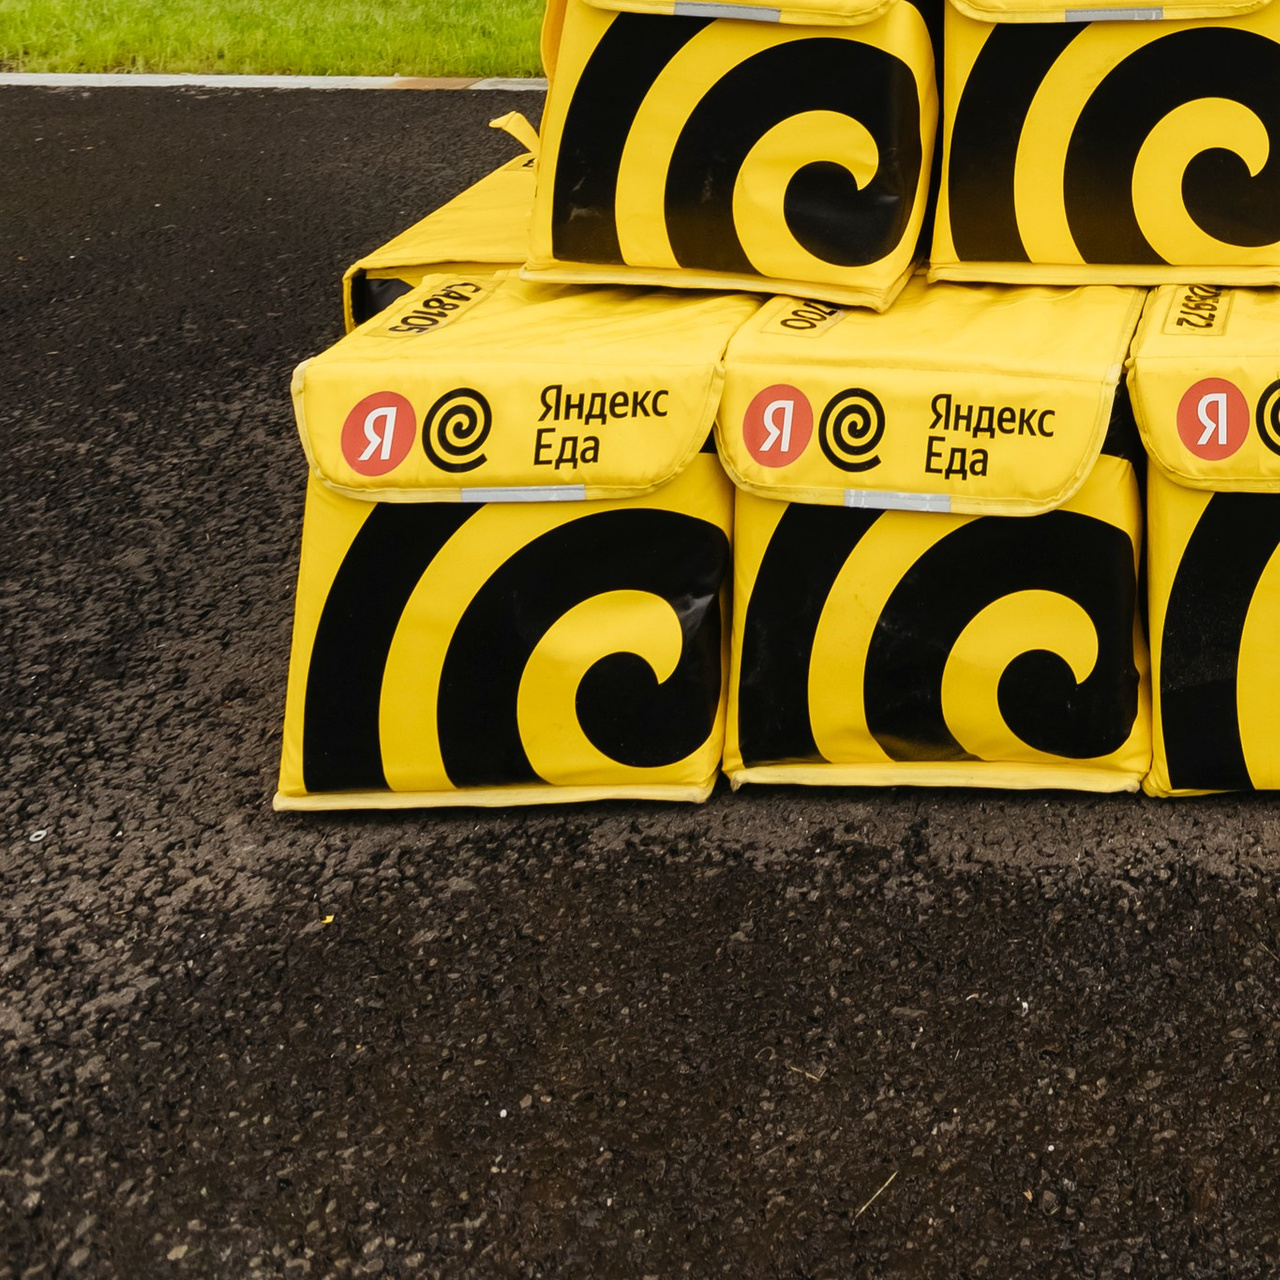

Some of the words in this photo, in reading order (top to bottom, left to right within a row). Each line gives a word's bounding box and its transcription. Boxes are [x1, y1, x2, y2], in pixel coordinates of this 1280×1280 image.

[387, 282, 482, 334] CA8105
[538, 384, 669, 426] Яндекс
[929, 393, 1056, 439] Яндекс
[533, 427, 600, 470] Еда
[924, 435, 989, 481] Еда
